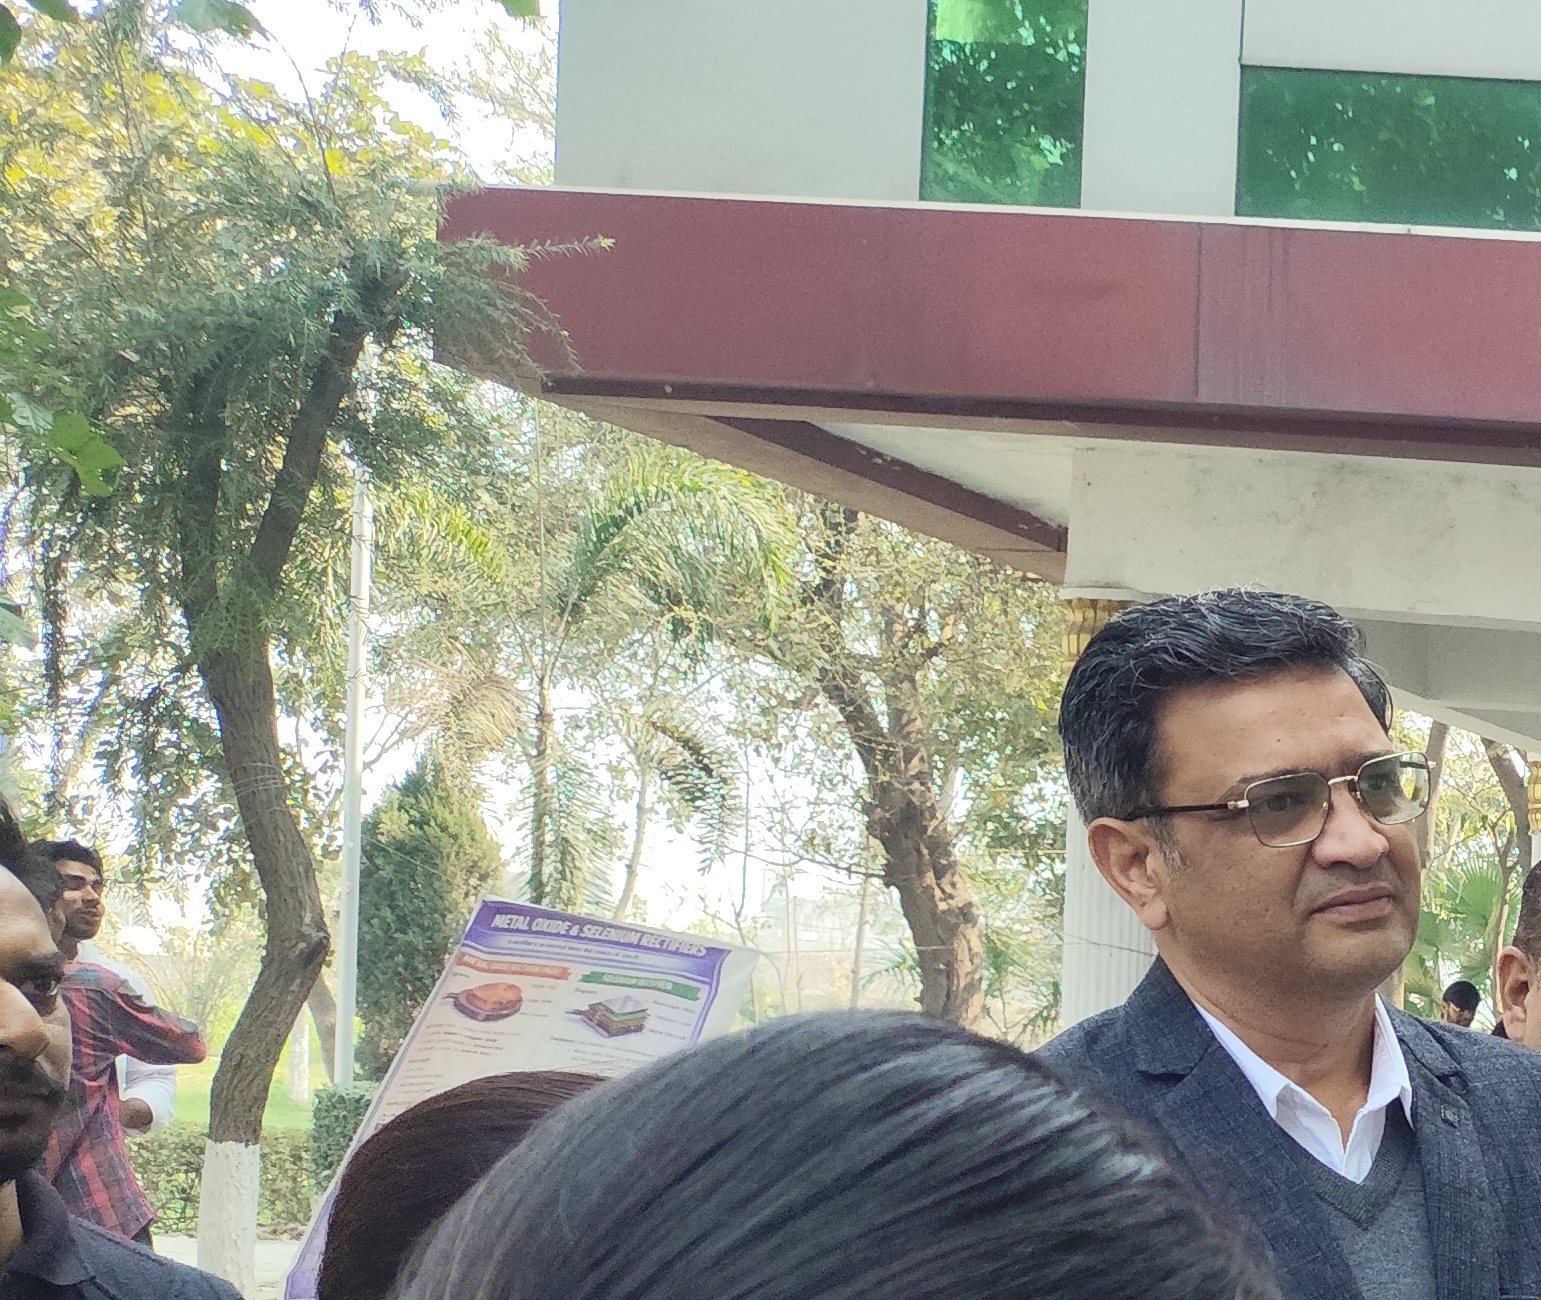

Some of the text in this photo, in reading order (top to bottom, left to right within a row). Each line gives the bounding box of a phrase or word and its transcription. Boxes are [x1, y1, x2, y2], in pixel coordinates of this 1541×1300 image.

[491, 914, 531, 930] METAL
[532, 918, 573, 935] OXIDE
[580, 924, 642, 946] SELENIUM
[640, 932, 708, 958] RECTIFIERS
